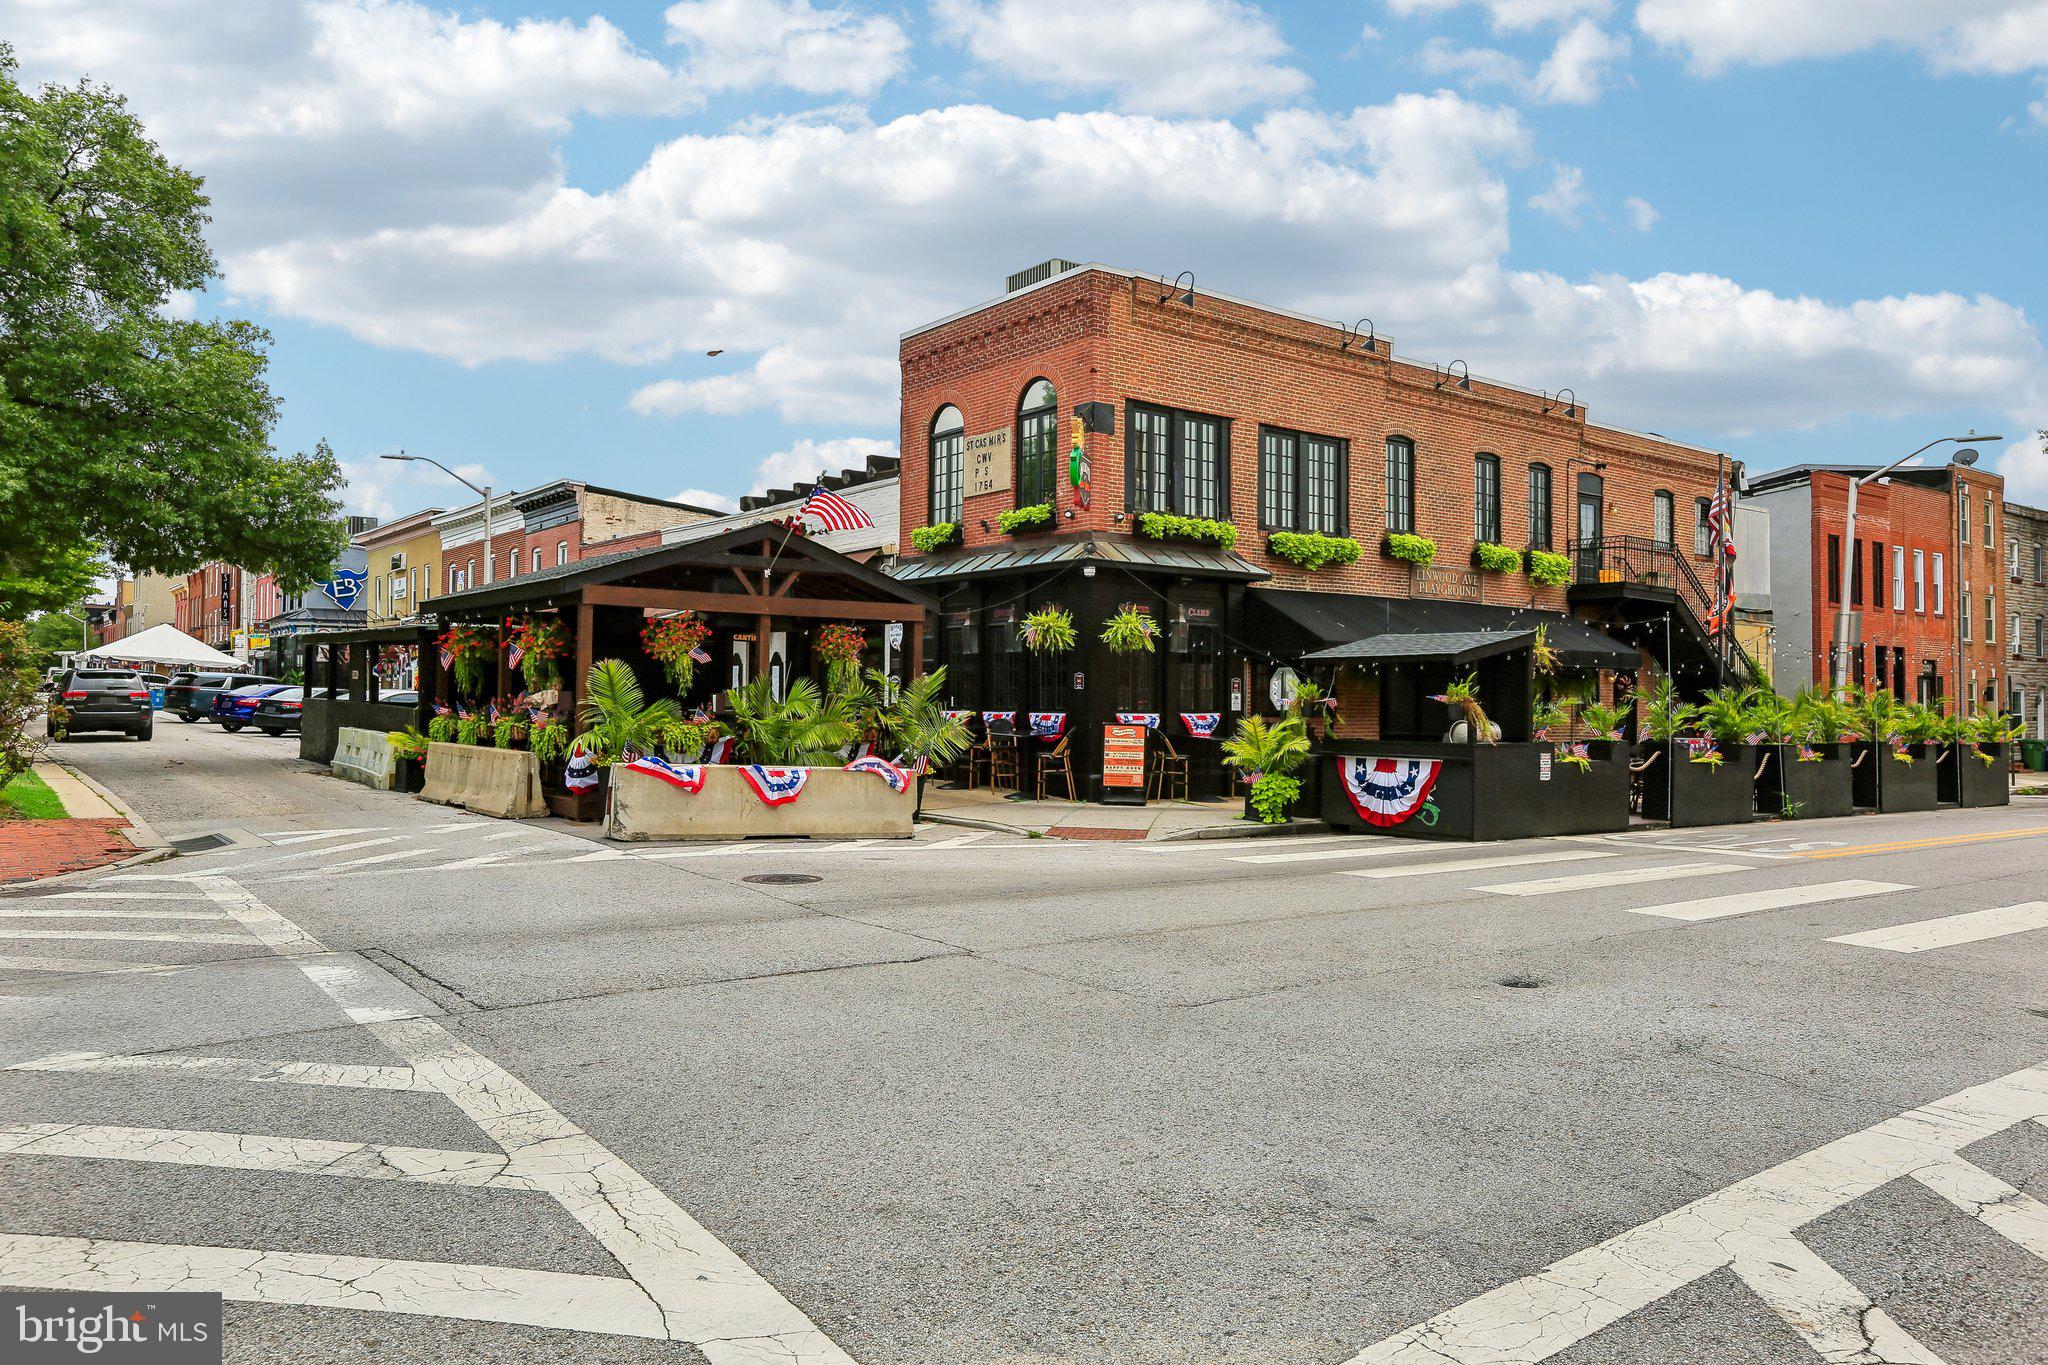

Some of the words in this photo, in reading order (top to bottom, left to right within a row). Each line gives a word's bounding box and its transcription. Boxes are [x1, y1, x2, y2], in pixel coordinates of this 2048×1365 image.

[967, 440, 974, 451] ST
[977, 452, 992, 463] CWV
[974, 479, 993, 492] 1764
[1416, 569, 1458, 584] LINWOOD
[1462, 574, 1479, 586] AVE
[1418, 581, 1478, 597] PLAYGROUND
